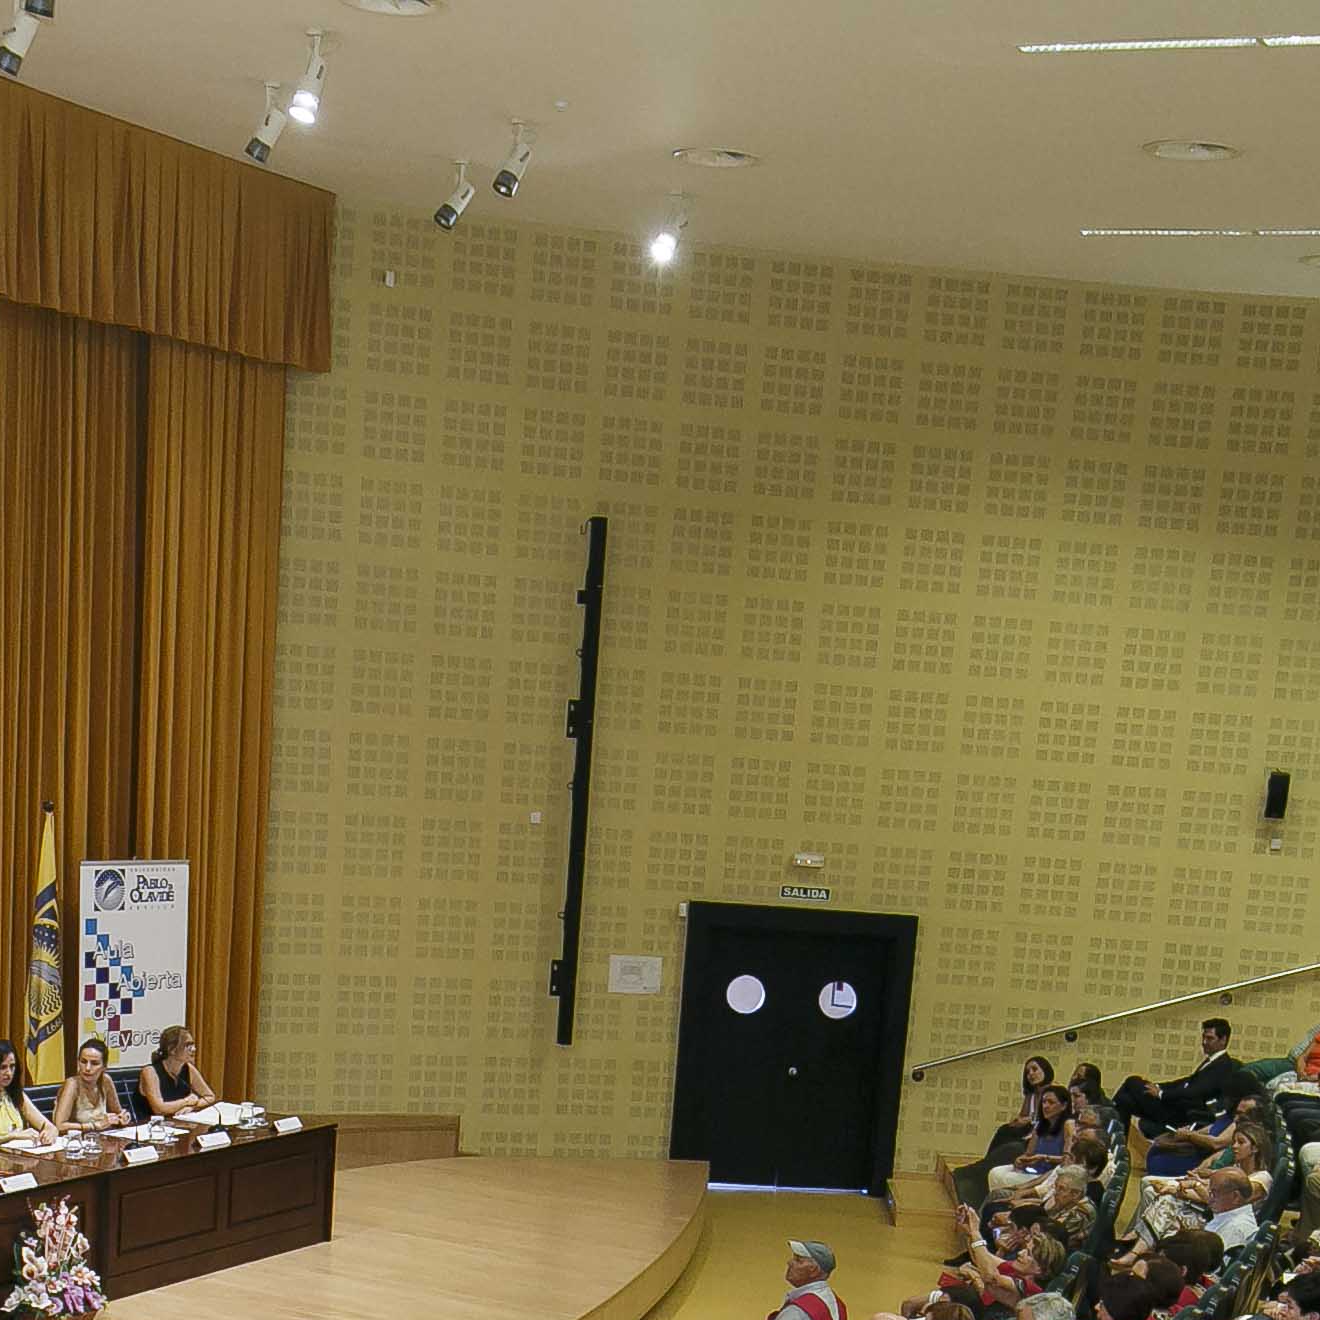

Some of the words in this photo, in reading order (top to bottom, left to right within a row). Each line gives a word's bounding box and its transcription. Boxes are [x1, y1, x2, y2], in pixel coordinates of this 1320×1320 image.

[136, 875, 169, 890] PABLO
[129, 888, 175, 903] OLAVIDE
[783, 887, 827, 899] SALIDA
[92, 940, 135, 960] Aula
[116, 970, 183, 991] Abierta
[92, 1002, 117, 1020] de
